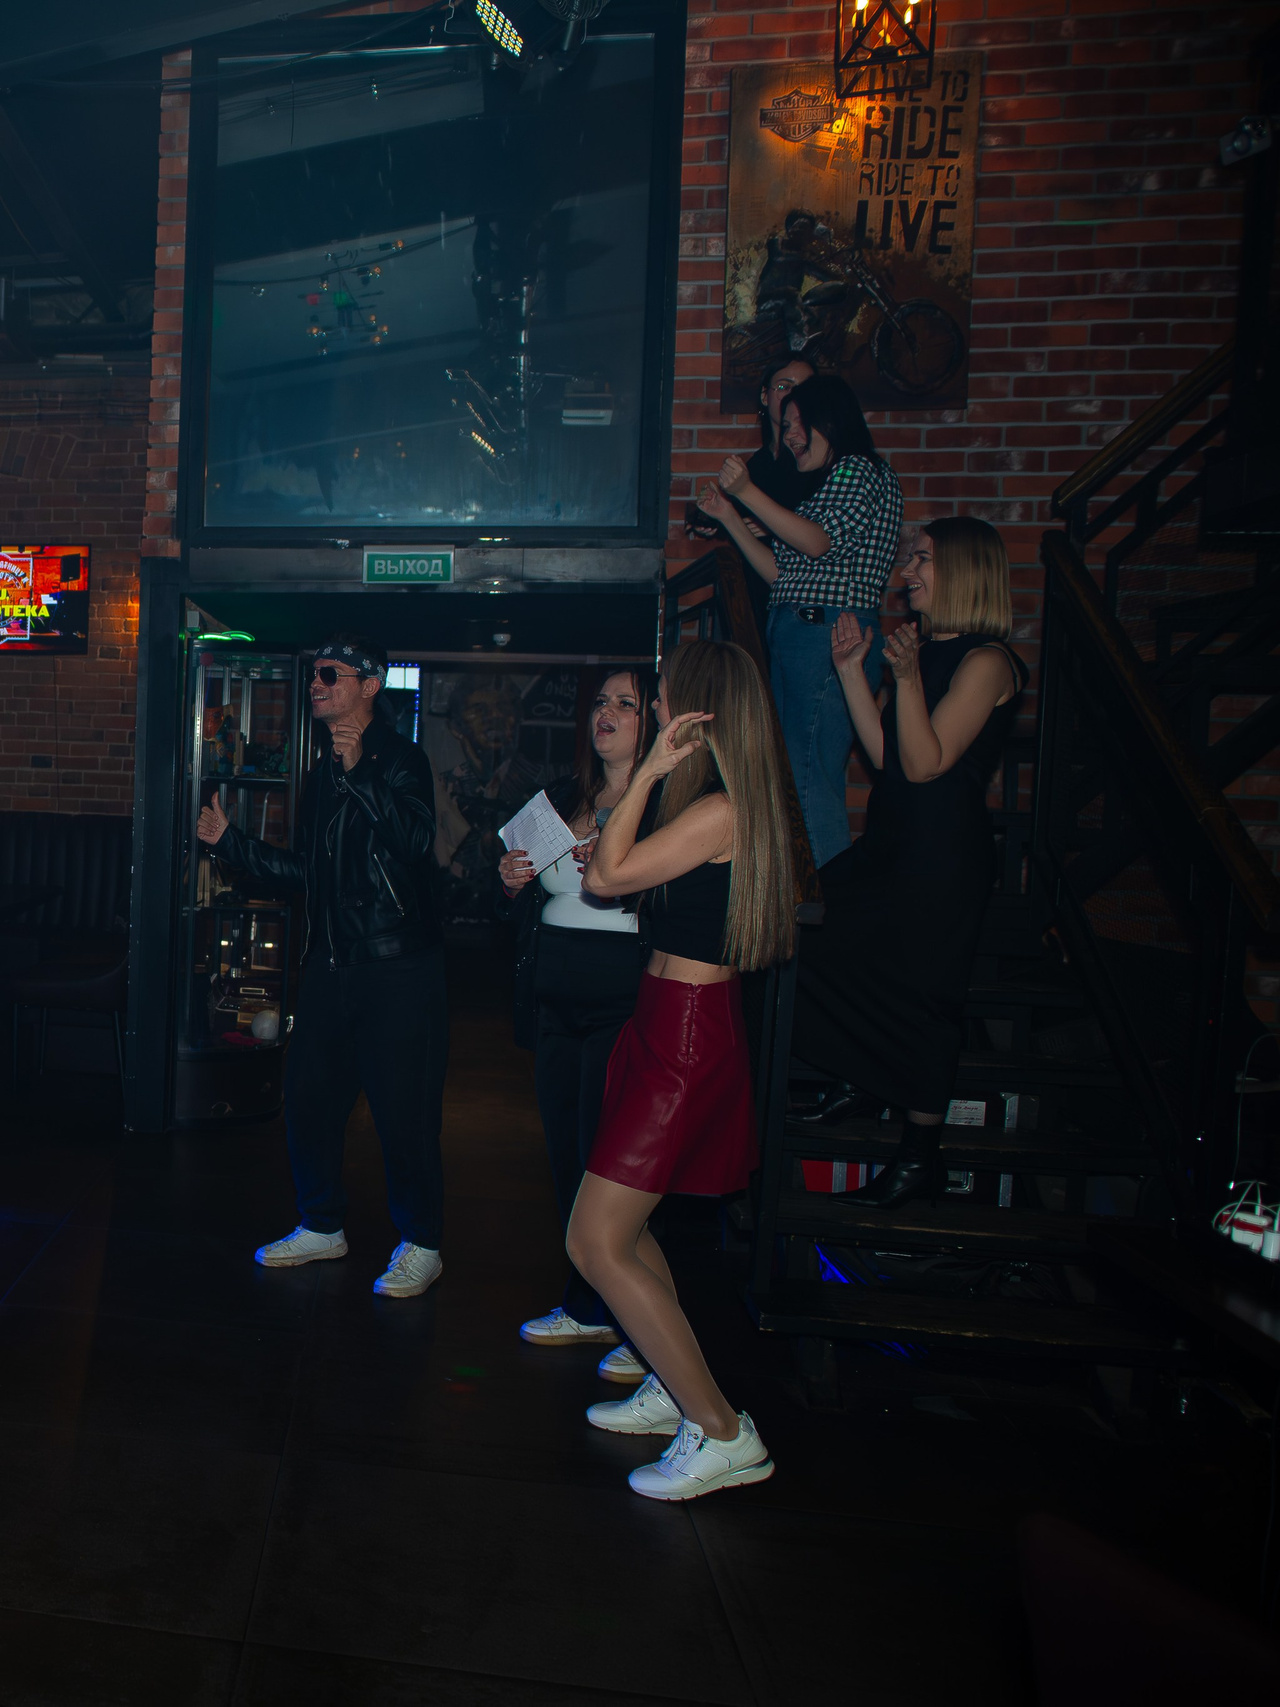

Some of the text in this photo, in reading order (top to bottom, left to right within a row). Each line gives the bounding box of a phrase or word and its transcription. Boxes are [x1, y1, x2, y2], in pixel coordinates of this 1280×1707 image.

[940, 70, 970, 102] TO
[862, 104, 964, 159] RIDE
[859, 161, 961, 197] RIDE TO
[854, 200, 958, 254] LIVE
[374, 559, 444, 577] ВЫХОД
